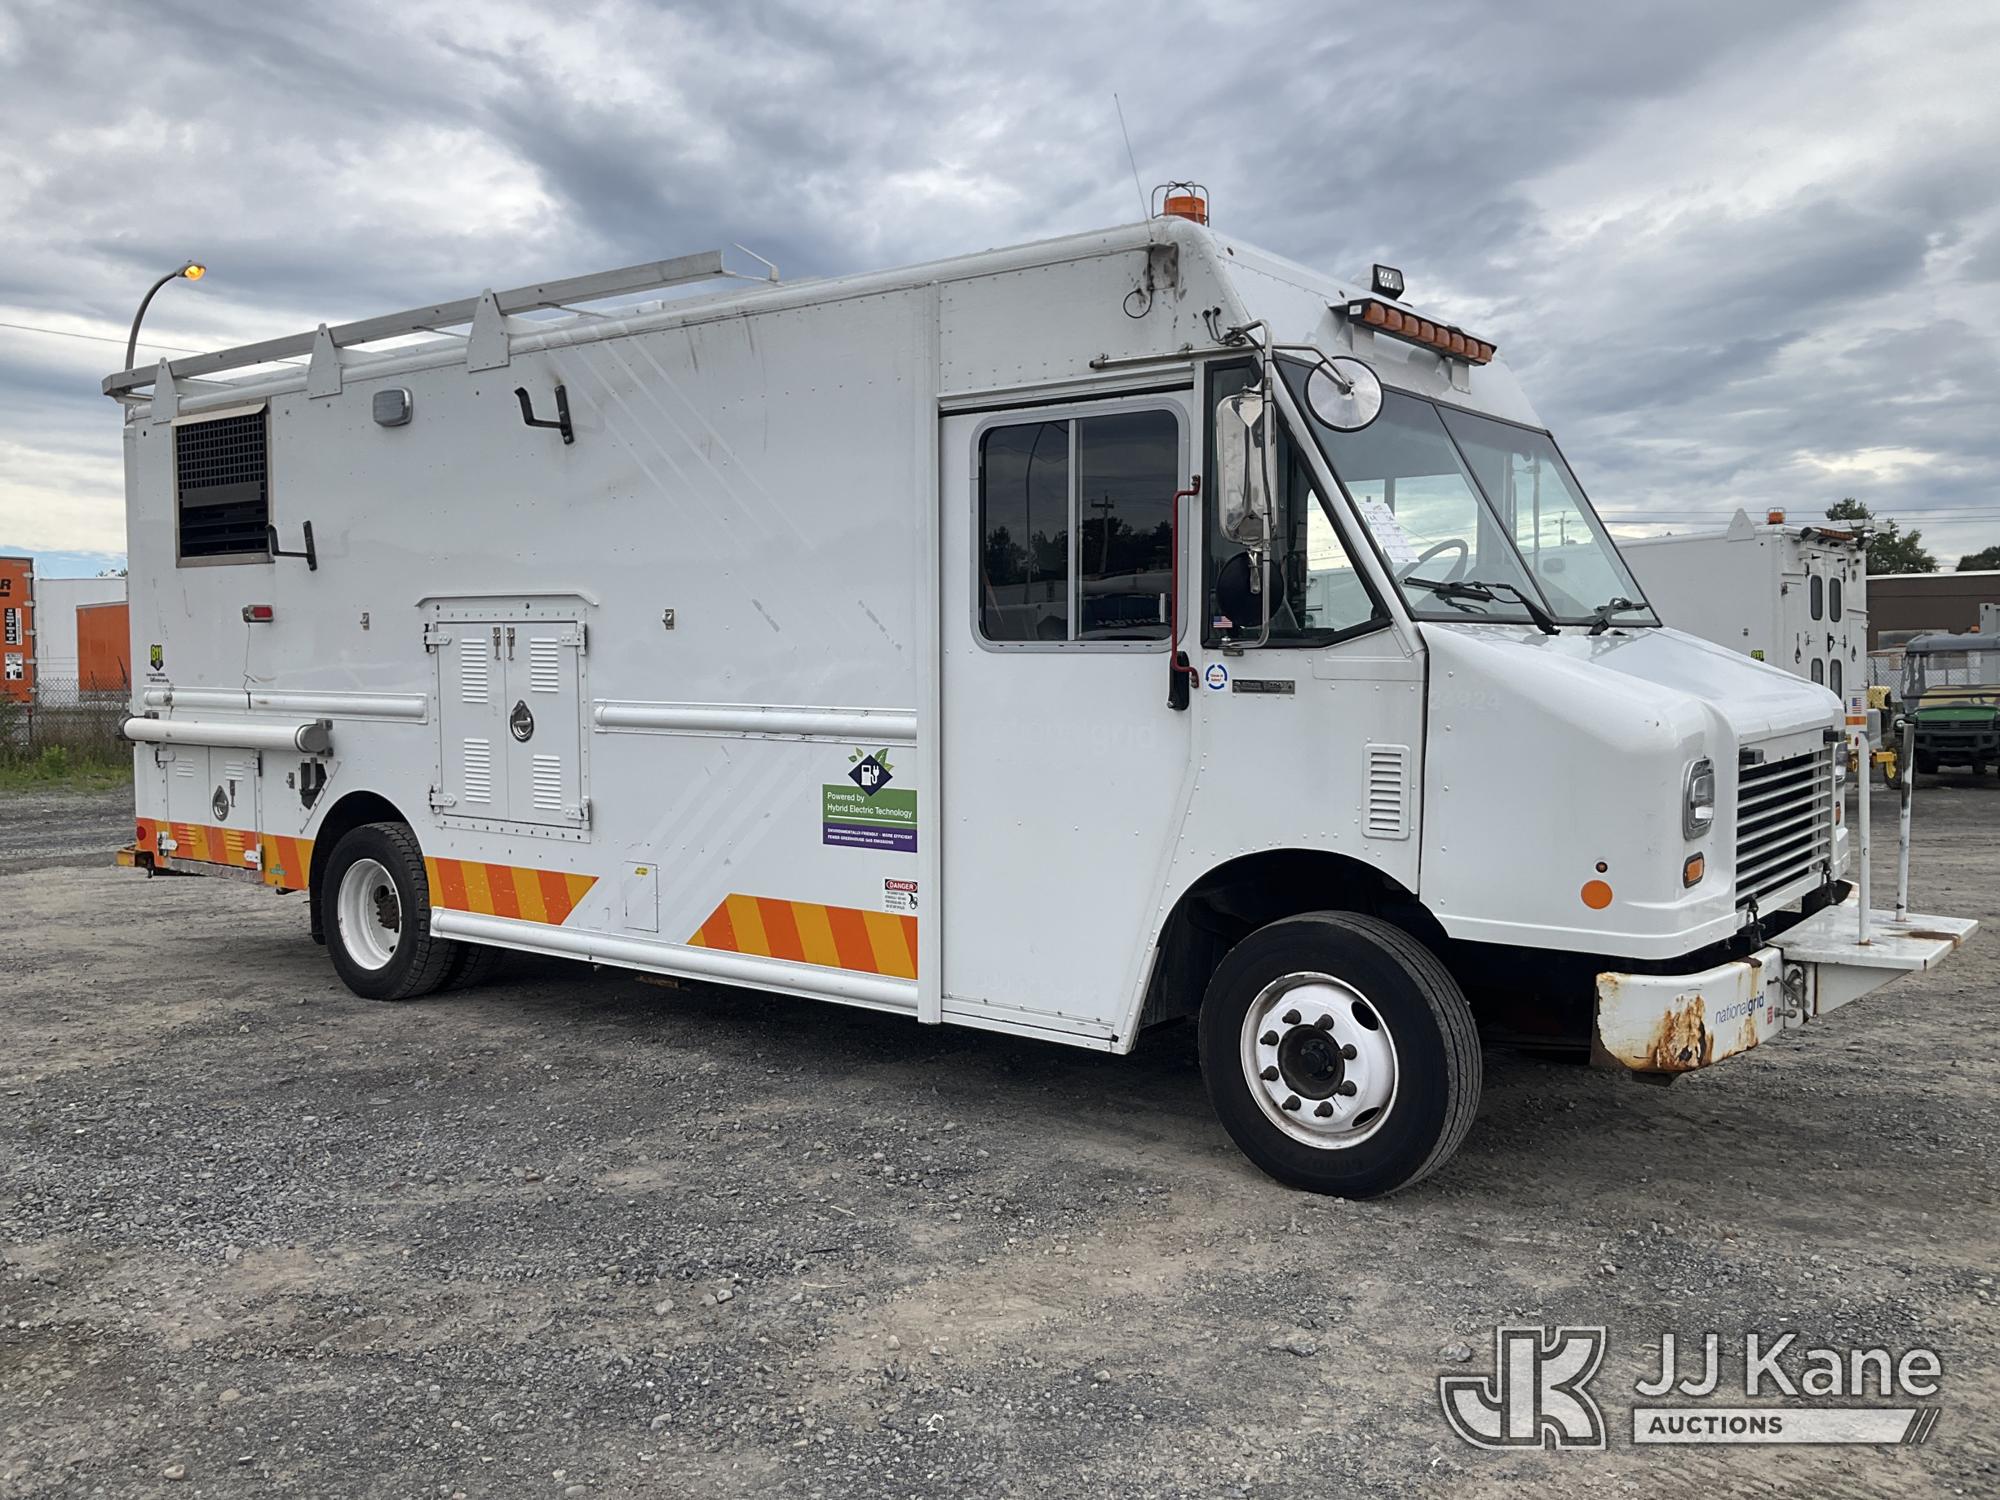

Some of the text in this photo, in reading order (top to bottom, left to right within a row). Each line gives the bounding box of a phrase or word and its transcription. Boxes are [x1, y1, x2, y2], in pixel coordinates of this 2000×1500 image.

[151, 646, 162, 661] 811
[827, 792, 865, 804] Powered by
[827, 803, 913, 819] Hybrid Electric Technology
[889, 881, 914, 890] DANGER
[1715, 991, 1765, 1024] nationalgrid
